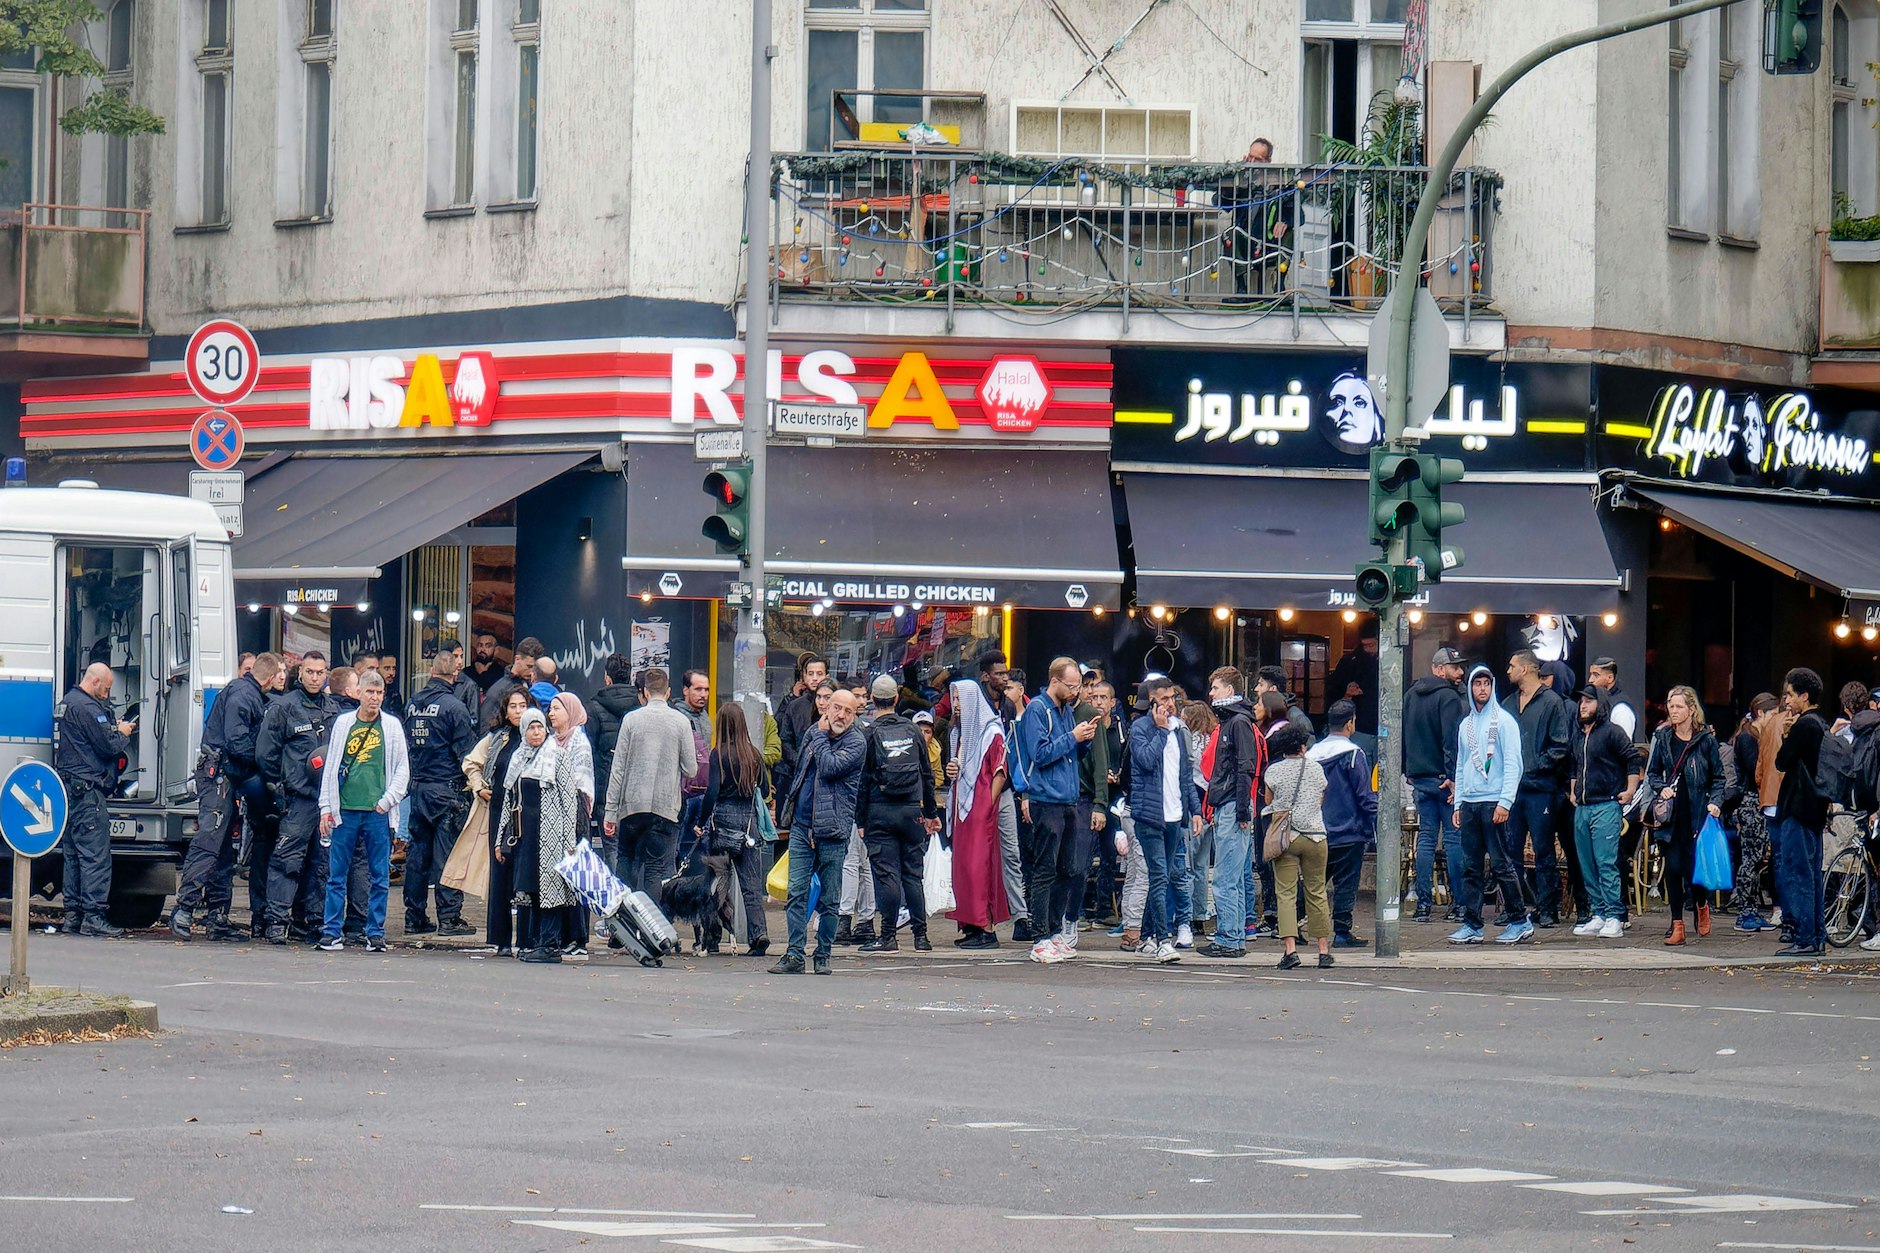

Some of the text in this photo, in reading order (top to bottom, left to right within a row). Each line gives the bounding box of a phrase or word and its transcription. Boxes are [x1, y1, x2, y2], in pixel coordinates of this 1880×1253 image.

[203, 344, 242, 381] 30
[997, 372, 1031, 384] Halal
[310, 353, 454, 430] RISA
[671, 347, 960, 430] RISA
[780, 408, 859, 430] Reuterstraße
[1175, 378, 1310, 445] فيروز
[200, 578, 208, 594] 4
[286, 588, 338, 602] RISA CHICKEN
[832, 583, 910, 600] GRILLED
[914, 586, 995, 602] CHICKEN
[294, 724, 313, 734] POLIZEI
[882, 738, 914, 748] Reebok
